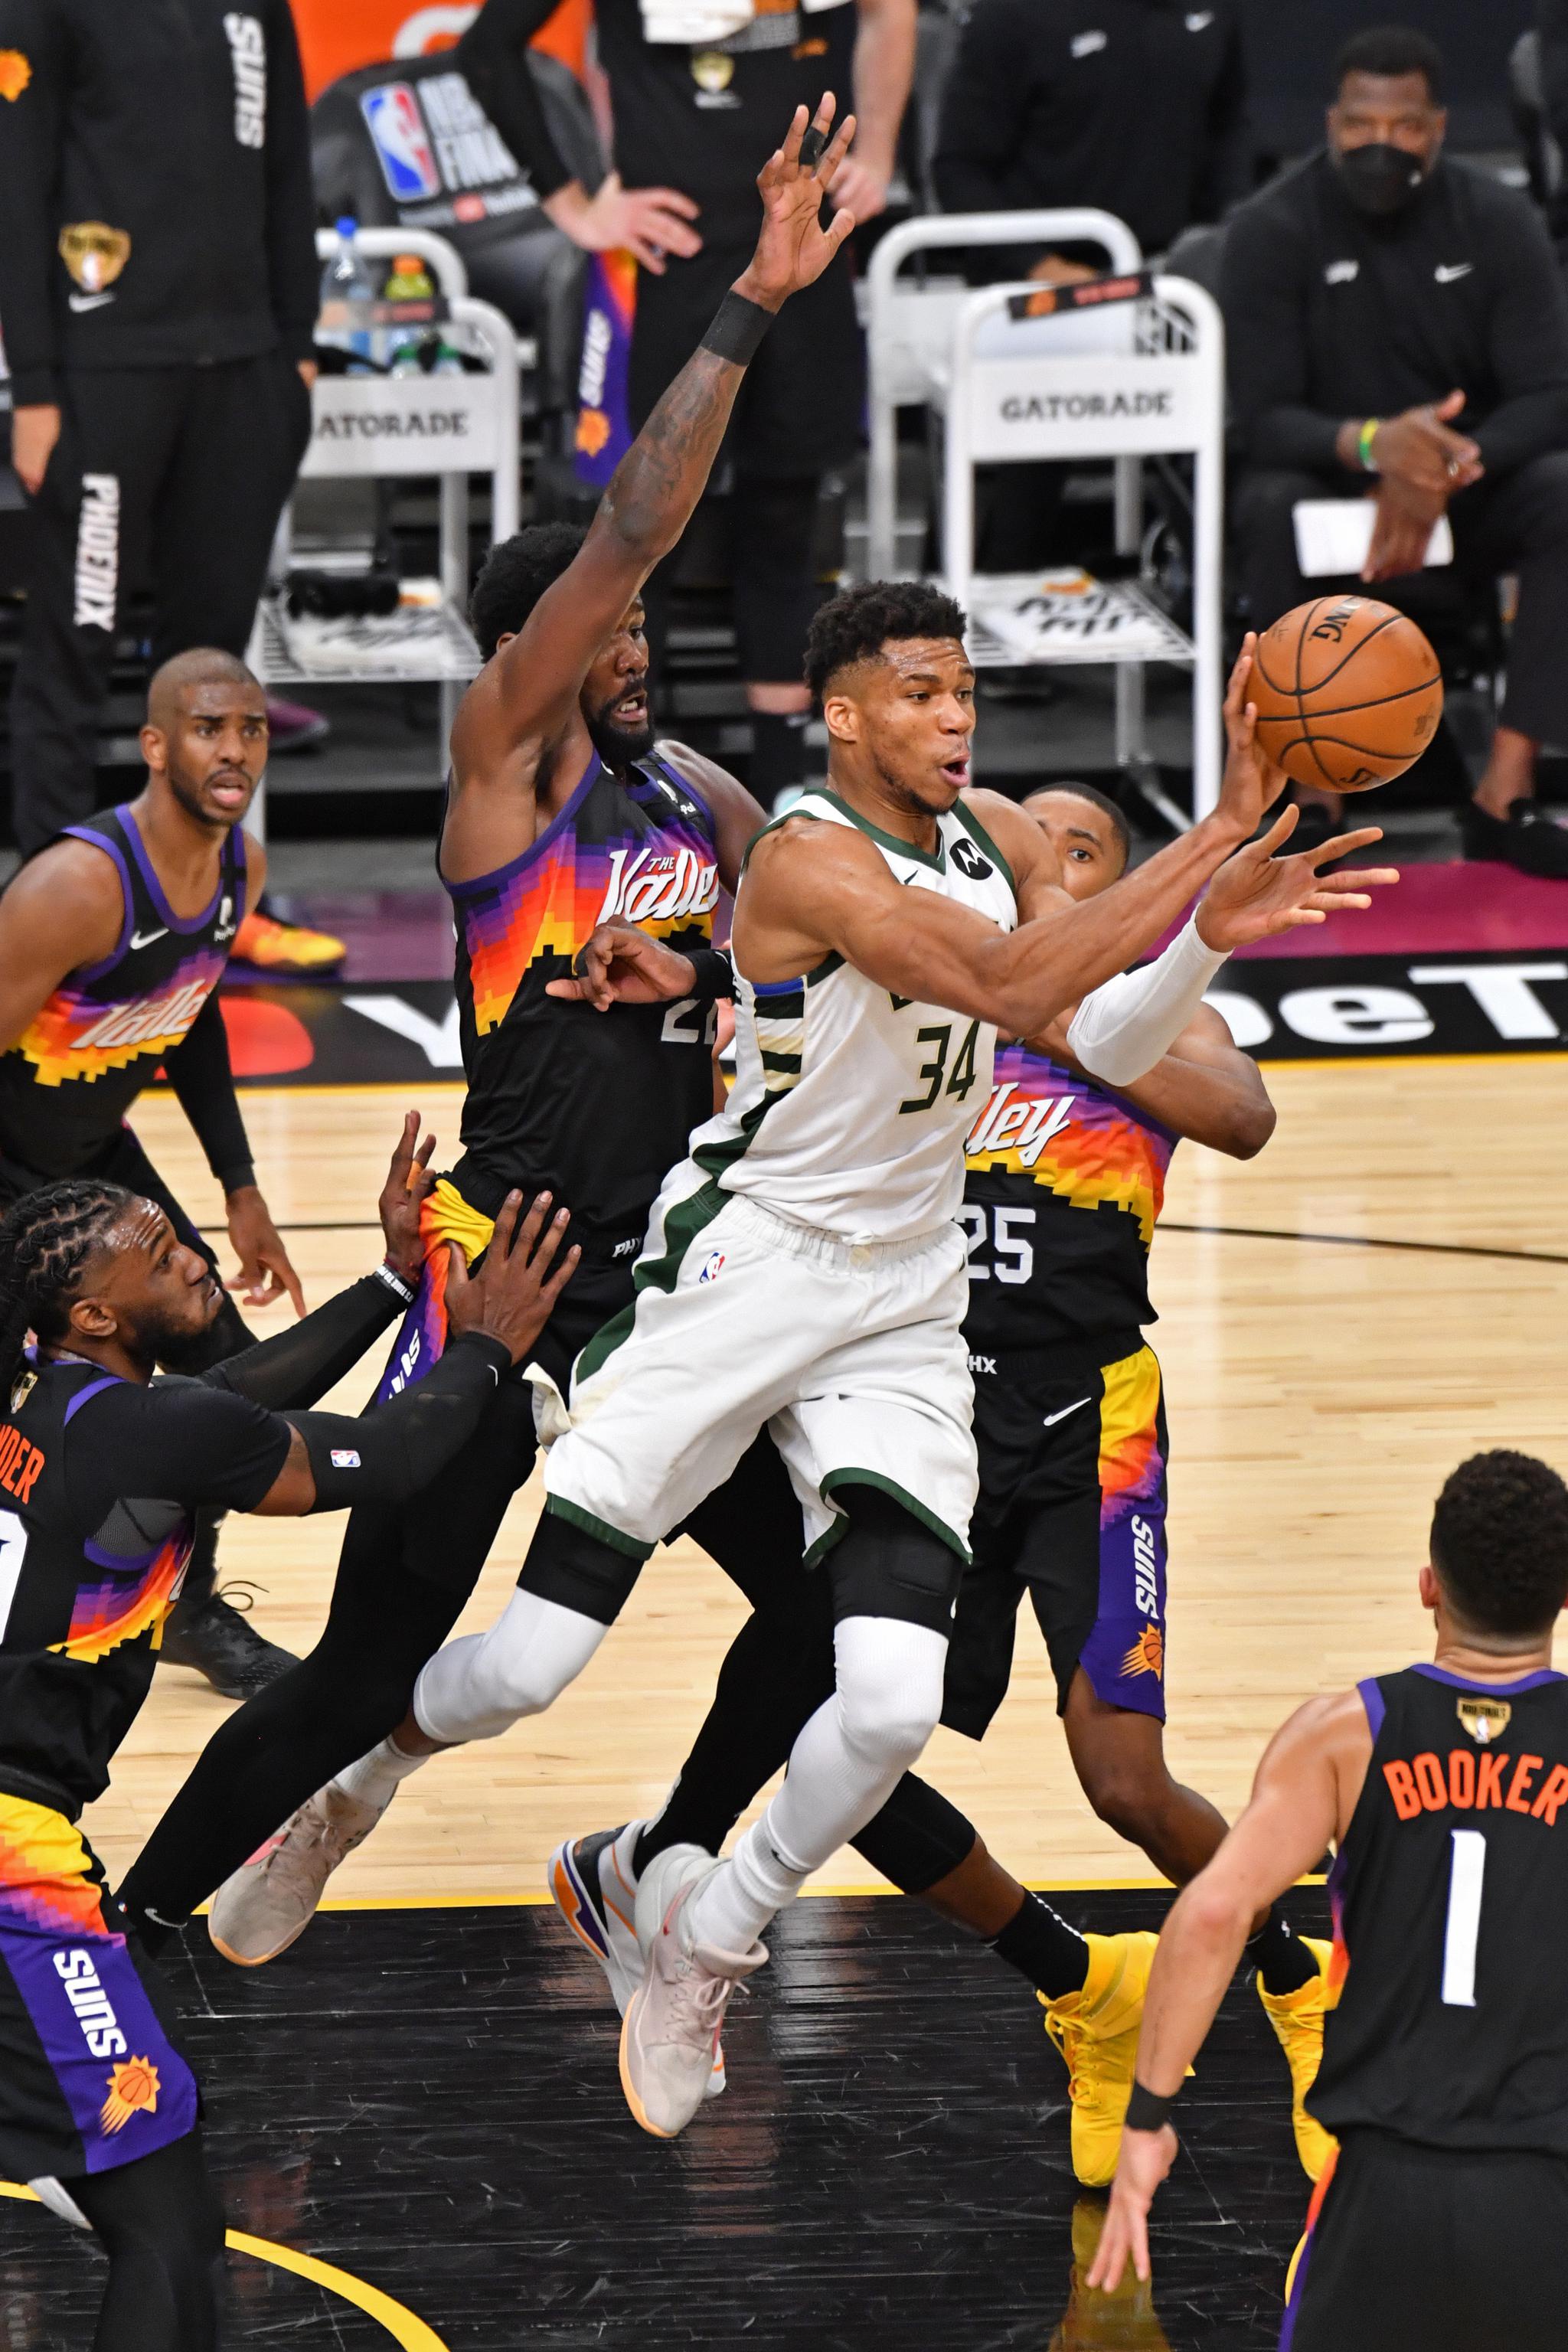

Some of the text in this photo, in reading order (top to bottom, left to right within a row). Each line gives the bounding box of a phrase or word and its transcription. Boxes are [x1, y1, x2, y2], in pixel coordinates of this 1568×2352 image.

[223, 11, 266, 149] SUNS
[318, 410, 468, 439] ATORADE
[1000, 390, 1172, 421] GATORADE
[74, 473, 119, 632] PHOENIX
[595, 848, 720, 927] Valle
[646, 857, 675, 873] THE
[68, 978, 208, 1049] Valle
[898, 1019, 980, 1115] 34
[954, 1204, 1037, 1285] 25
[968, 1355, 998, 1375] HX
[1131, 1514, 1160, 1620] SUNS
[1382, 1749, 1568, 1827] BOOKER
[1442, 1828, 1487, 2007] 1
[53, 1949, 127, 2058] SUNS
